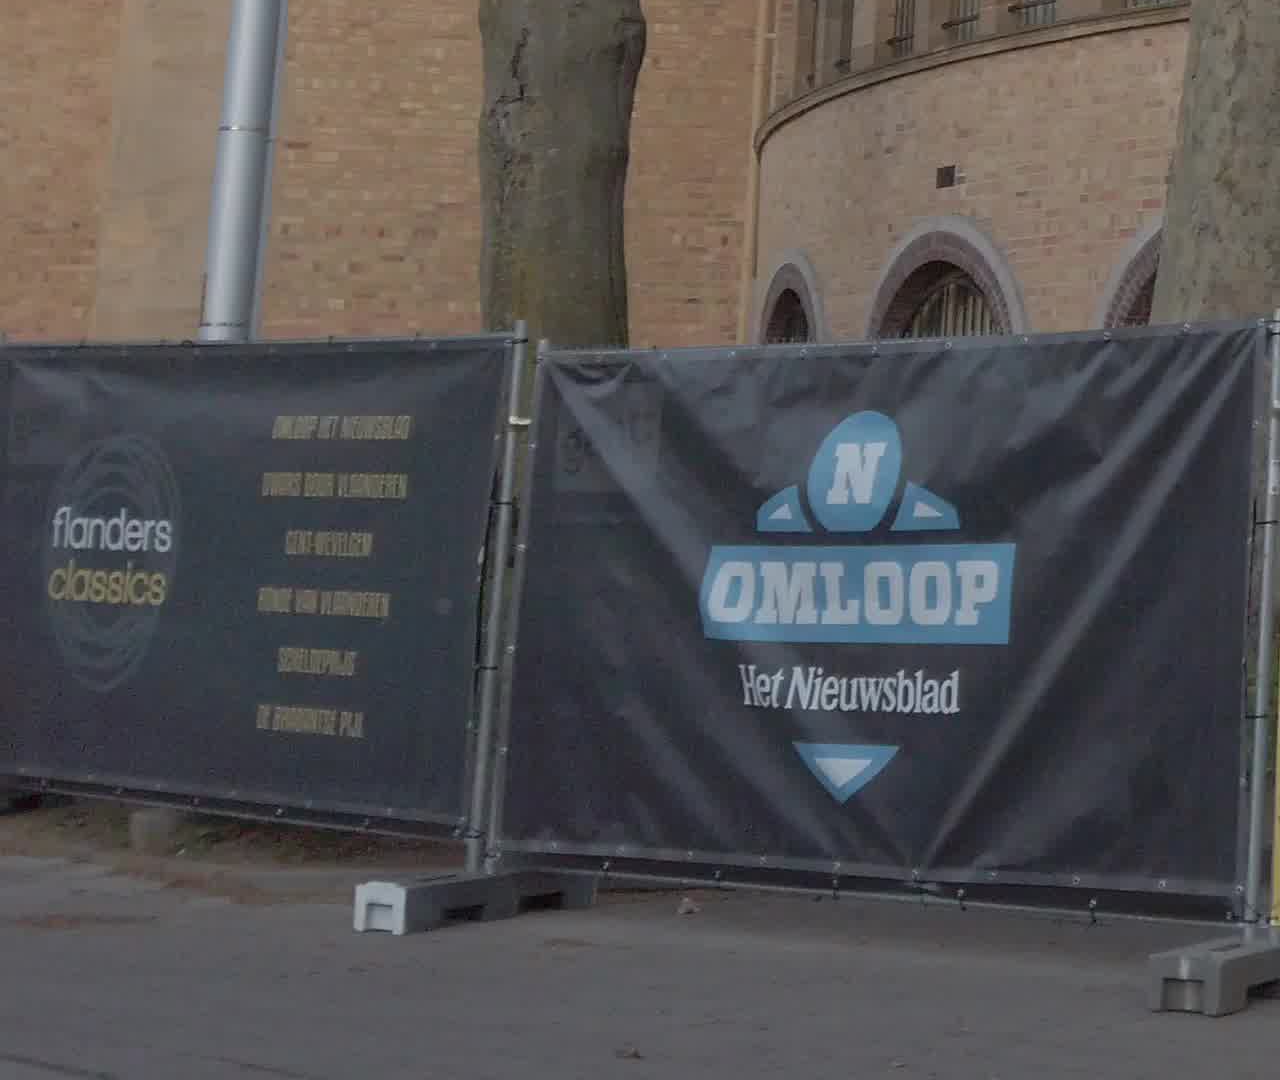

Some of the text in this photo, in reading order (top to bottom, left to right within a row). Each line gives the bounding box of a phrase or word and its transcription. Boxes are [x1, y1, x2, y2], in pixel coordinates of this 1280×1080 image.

[826, 441, 888, 505] N
[52, 506, 172, 552] flanders
[48, 559, 167, 606] classics
[707, 559, 1000, 627] OMLOOP
[738, 664, 960, 714] Het Nieuwsblad
